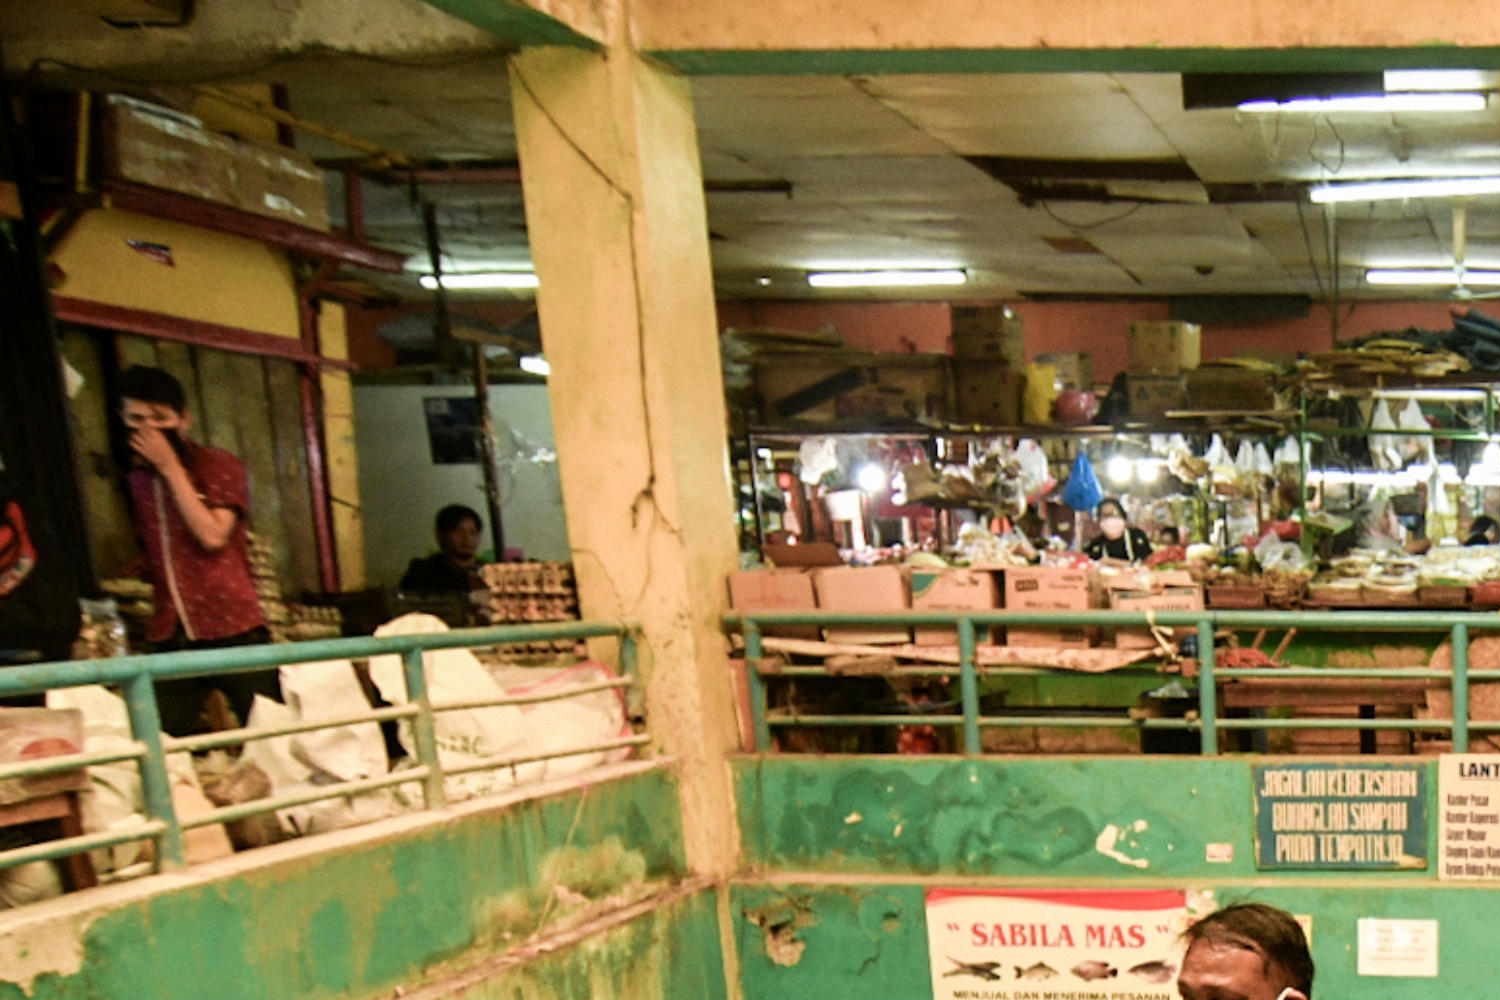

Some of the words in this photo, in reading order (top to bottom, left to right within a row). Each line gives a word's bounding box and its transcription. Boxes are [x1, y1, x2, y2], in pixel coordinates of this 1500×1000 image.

[1260, 769, 1326, 797] JAGALAH
[1327, 769, 1418, 797] KEBERSIHAN
[1272, 801, 1349, 832] BUANGLAH
[1350, 802, 1408, 832] SAMPAH
[1275, 833, 1316, 863] PADA
[971, 922, 1075, 948] SABILA
[1086, 924, 1146, 949] MAS
[953, 989, 1010, 1000] MENJUAL
[1014, 990, 1039, 1000] DAN
